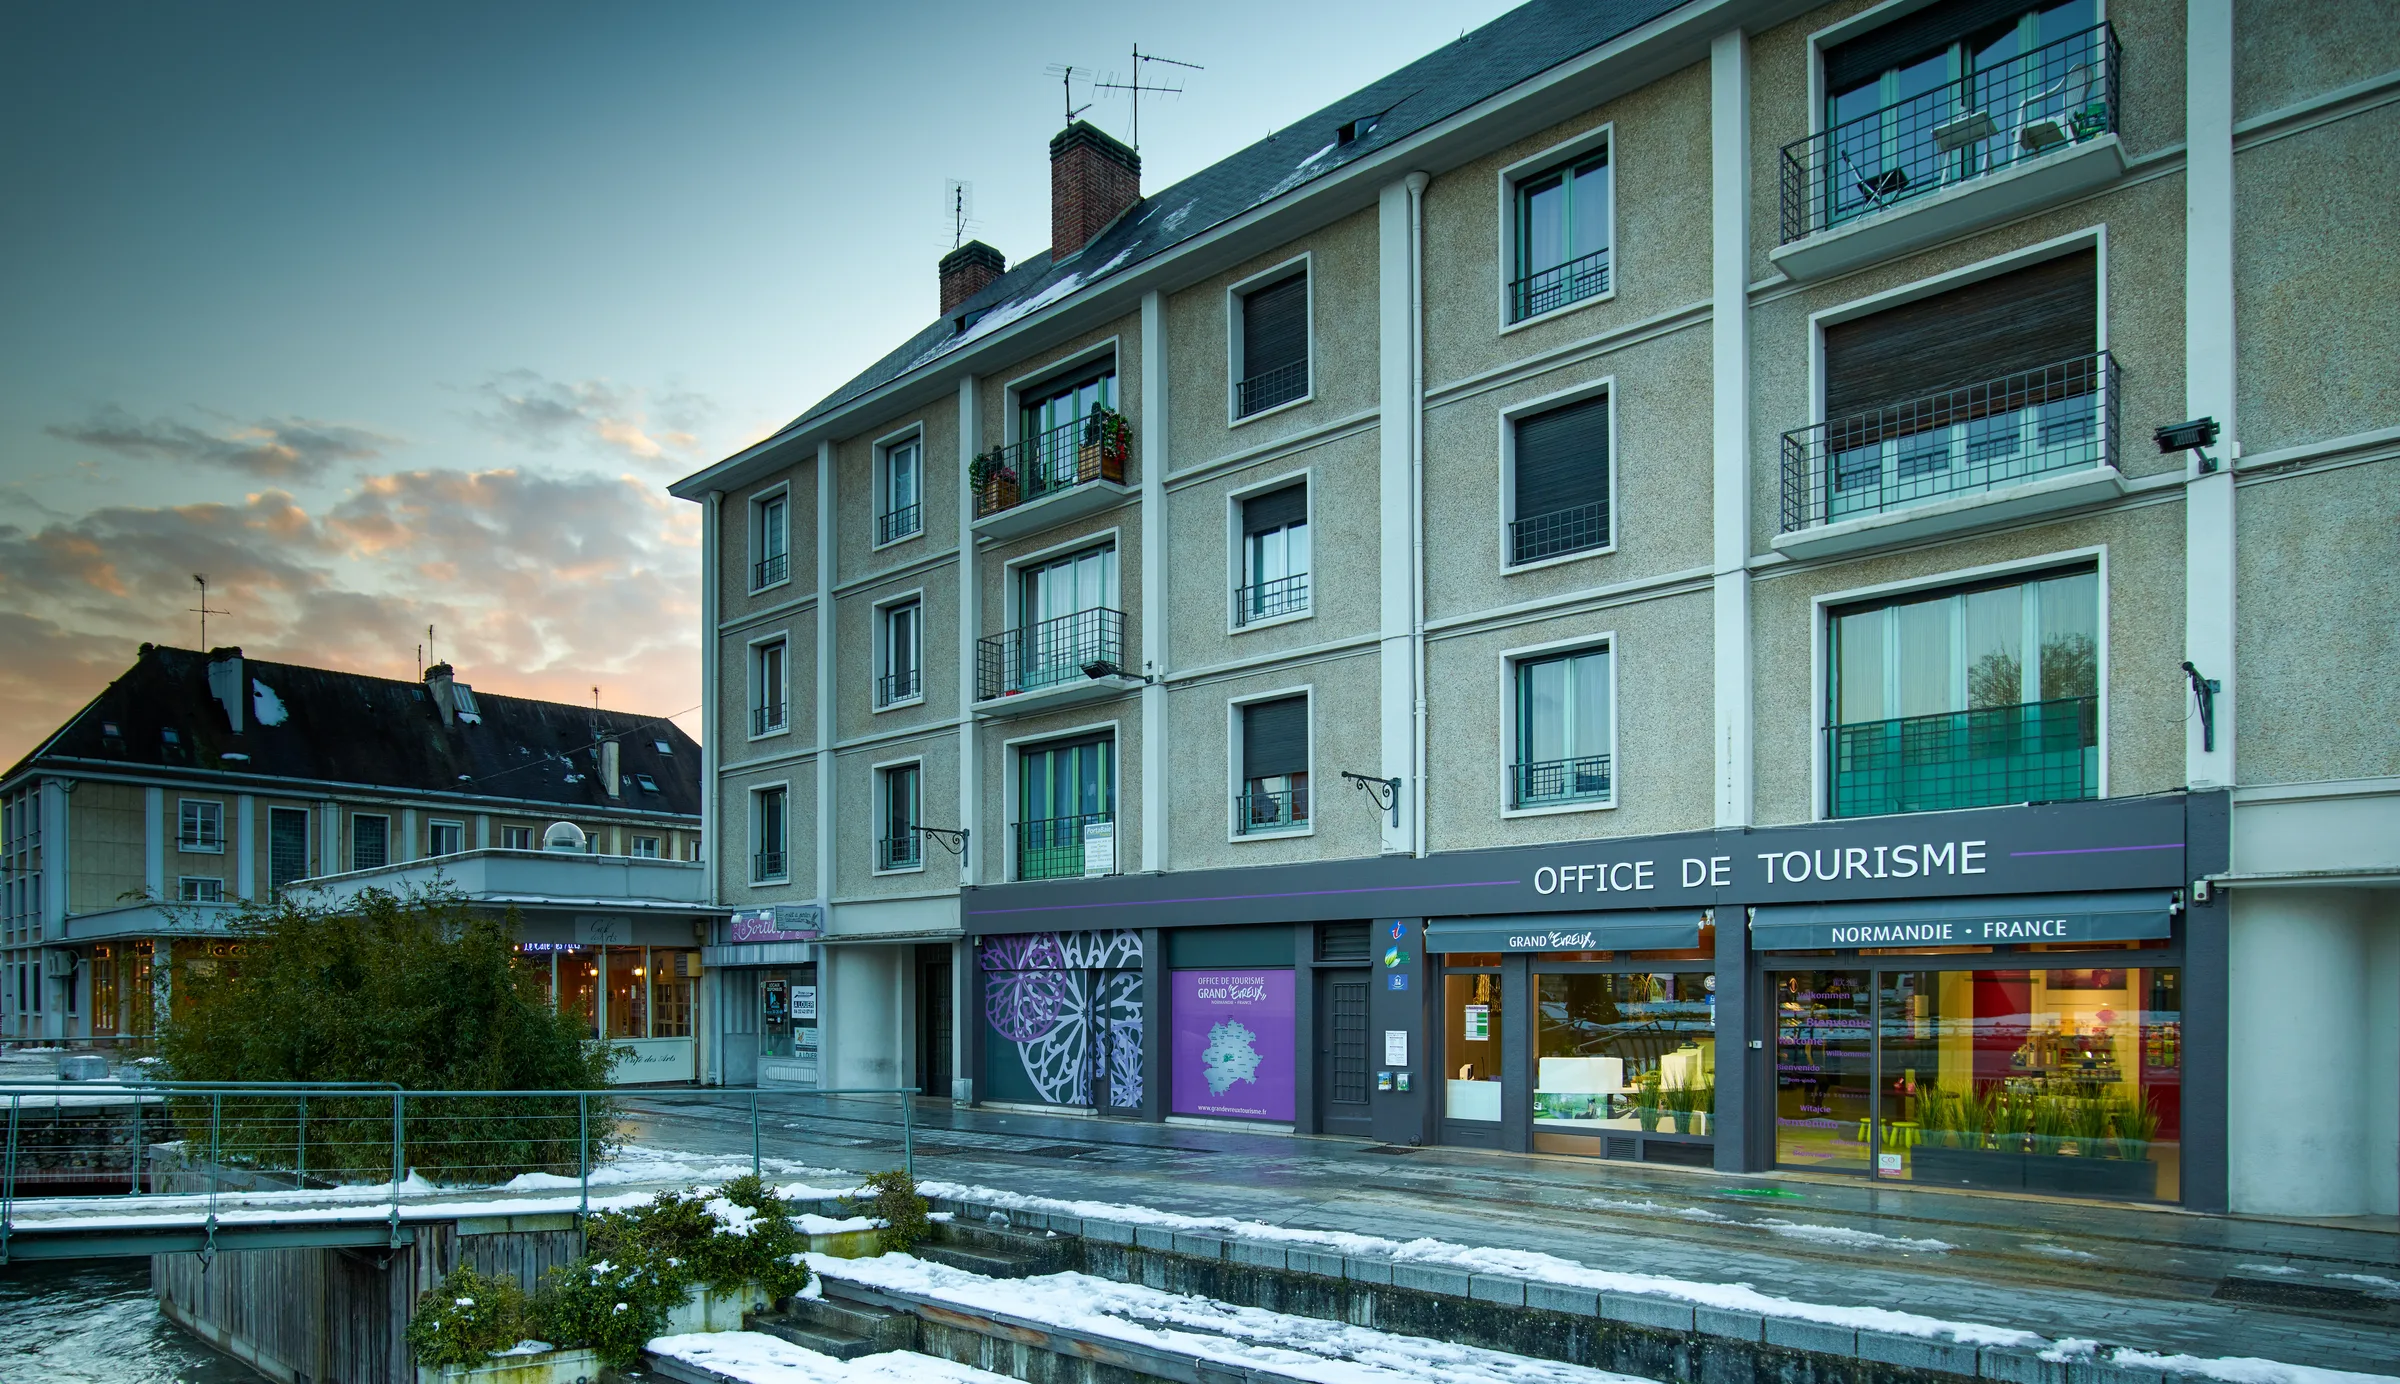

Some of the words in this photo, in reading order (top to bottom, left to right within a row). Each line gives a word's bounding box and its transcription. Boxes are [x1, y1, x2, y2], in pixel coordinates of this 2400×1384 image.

[1533, 860, 1655, 895] OFFICE
[1681, 855, 1732, 889] DE
[1758, 841, 1987, 883] TOURISME
[1831, 924, 1953, 943] NORMANDIE
[1983, 919, 2067, 938] FRANCE
[1509, 935, 1547, 948] GRAND
[1198, 976, 1219, 985] OFFICE
[1221, 976, 1229, 984] DE
[1231, 976, 1264, 985] TOURISME
[1197, 988, 1227, 999] GRAND
[1778, 1036, 1824, 1046] Welcome
[1777, 1064, 1820, 1072] Bienvenido
[1197, 1105, 1267, 1115] www.grandevreuxtourisme.fr
[1800, 1104, 1831, 1113] Witajcie
